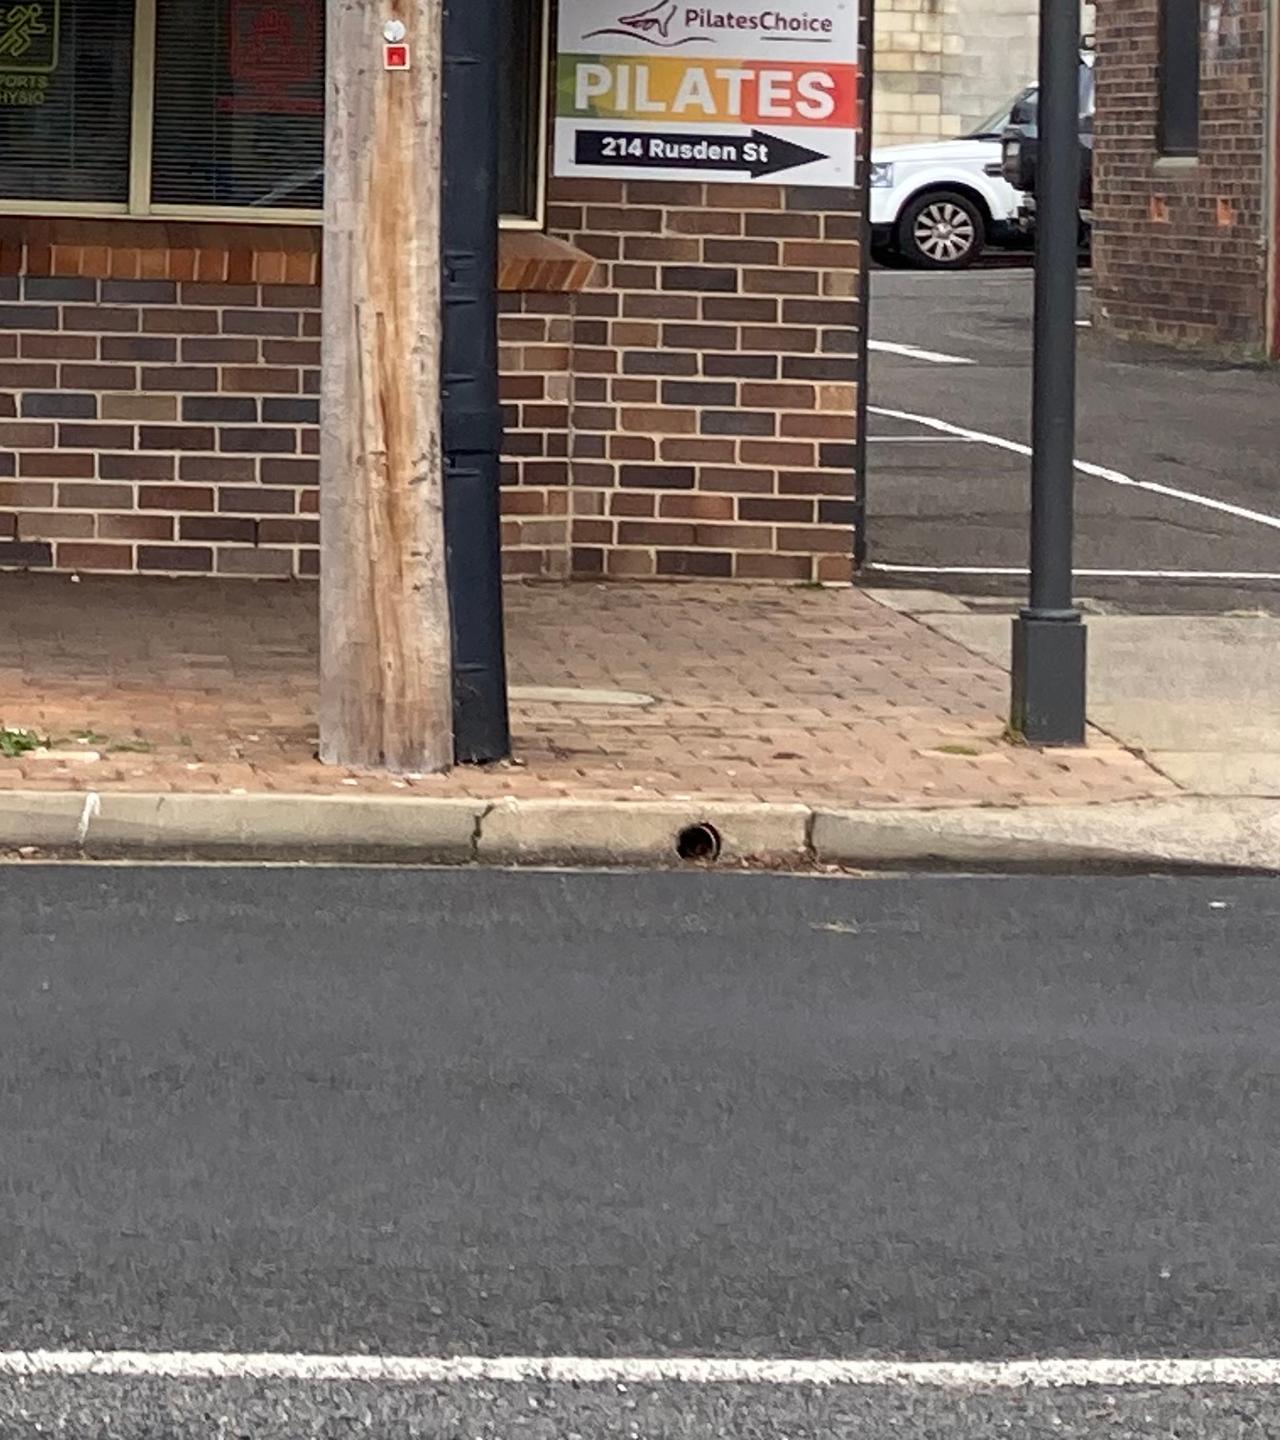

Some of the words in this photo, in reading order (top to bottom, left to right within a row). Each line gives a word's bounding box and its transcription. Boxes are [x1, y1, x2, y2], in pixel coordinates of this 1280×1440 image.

[685, 8, 833, 33] PilatesChoice
[575, 63, 835, 120] PILATES
[601, 136, 643, 157] 214
[649, 138, 737, 161] Rusden
[742, 142, 769, 163] St
